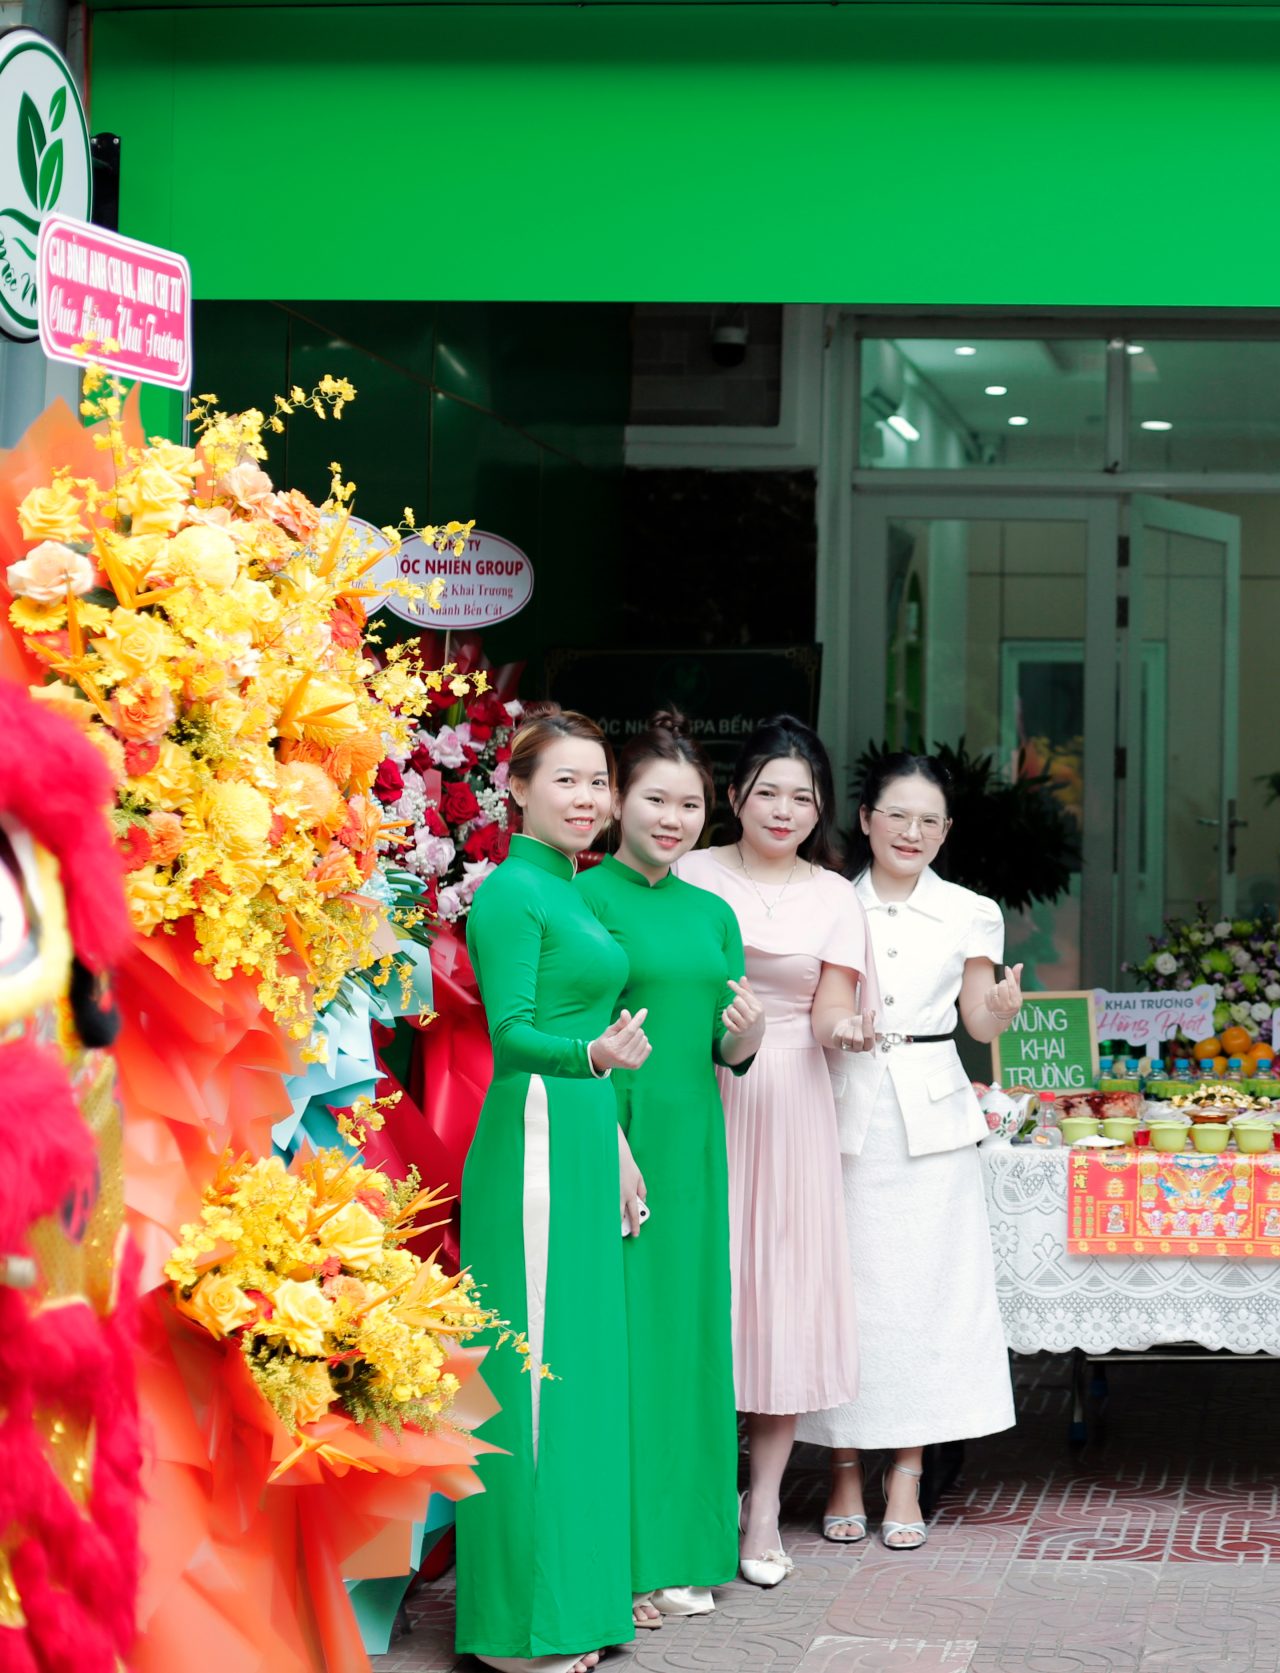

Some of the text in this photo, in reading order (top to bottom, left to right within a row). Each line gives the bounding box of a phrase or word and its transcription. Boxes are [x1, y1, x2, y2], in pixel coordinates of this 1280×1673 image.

[48, 236, 66, 278] GIA
[67, 234, 88, 286] ĐÌNH
[89, 249, 108, 292] ANH
[137, 266, 155, 307] ANH
[155, 272, 169, 318] CHỊ
[49, 284, 77, 336] Chúc
[115, 304, 142, 353] Khai
[468, 538, 481, 552] TY
[400, 553, 524, 578] ỘC NHIÊN GROUP
[451, 584, 475, 597] Khai
[718, 713, 753, 734] BẾN
[1105, 997, 1194, 1011] KHAI TRƯƠNG
[1020, 1037, 1066, 1060] KHAI
